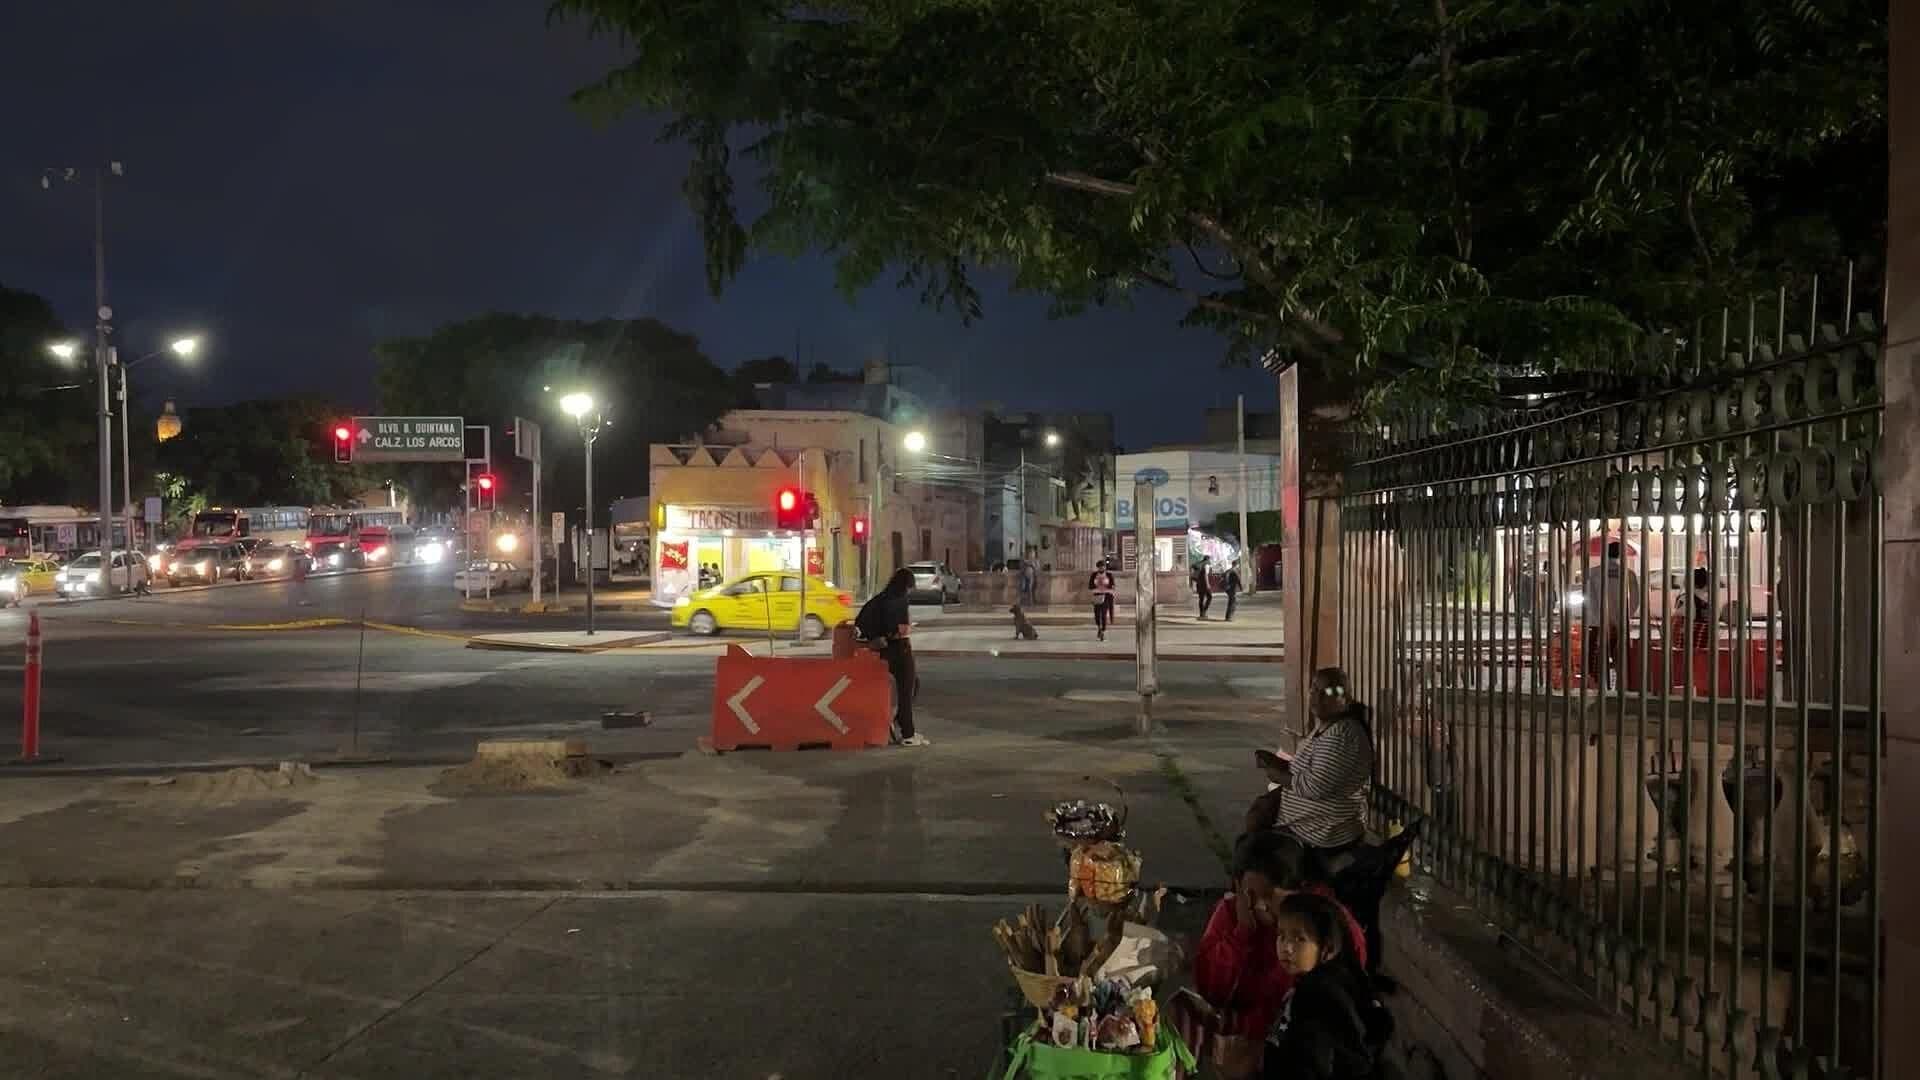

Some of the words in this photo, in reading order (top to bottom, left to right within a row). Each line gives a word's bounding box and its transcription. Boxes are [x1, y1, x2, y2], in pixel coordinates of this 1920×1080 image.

[415, 423, 455, 433] QUINTANA
[375, 437, 404, 447] CALZ.
[406, 437, 425, 447] LOS
[429, 437, 461, 447] ARCOS
[1117, 497, 1188, 517] BOS
[688, 510, 736, 529] TACOS
